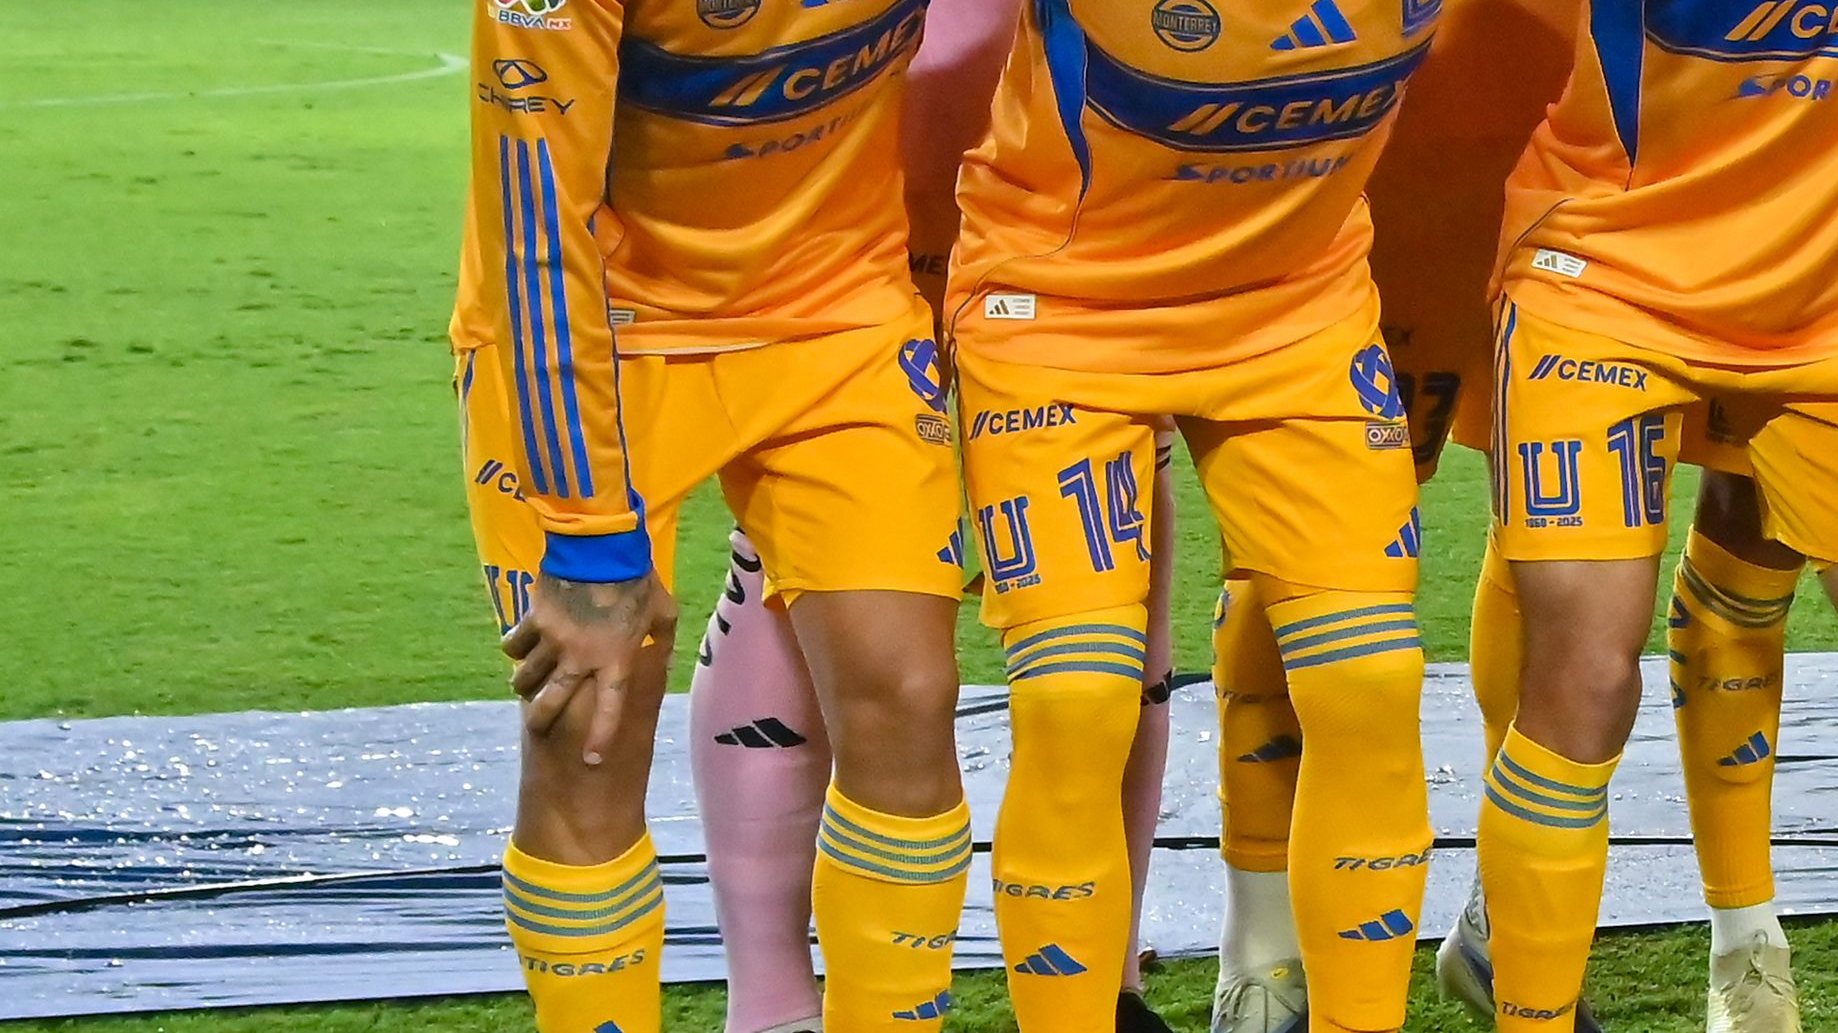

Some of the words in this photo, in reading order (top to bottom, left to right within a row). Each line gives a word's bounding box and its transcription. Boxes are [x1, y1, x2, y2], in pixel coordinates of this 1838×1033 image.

[499, 10, 545, 30] BBVA
[1153, 11, 1218, 34] MONTERREY
[1558, 359, 1649, 392] CEMEX
[988, 403, 1077, 436] CEMEX
[1517, 441, 1581, 516] U
[1607, 415, 1667, 528] 16
[979, 496, 1036, 583] U
[1057, 450, 1152, 574] 14
[523, 949, 646, 978] TIGRES
